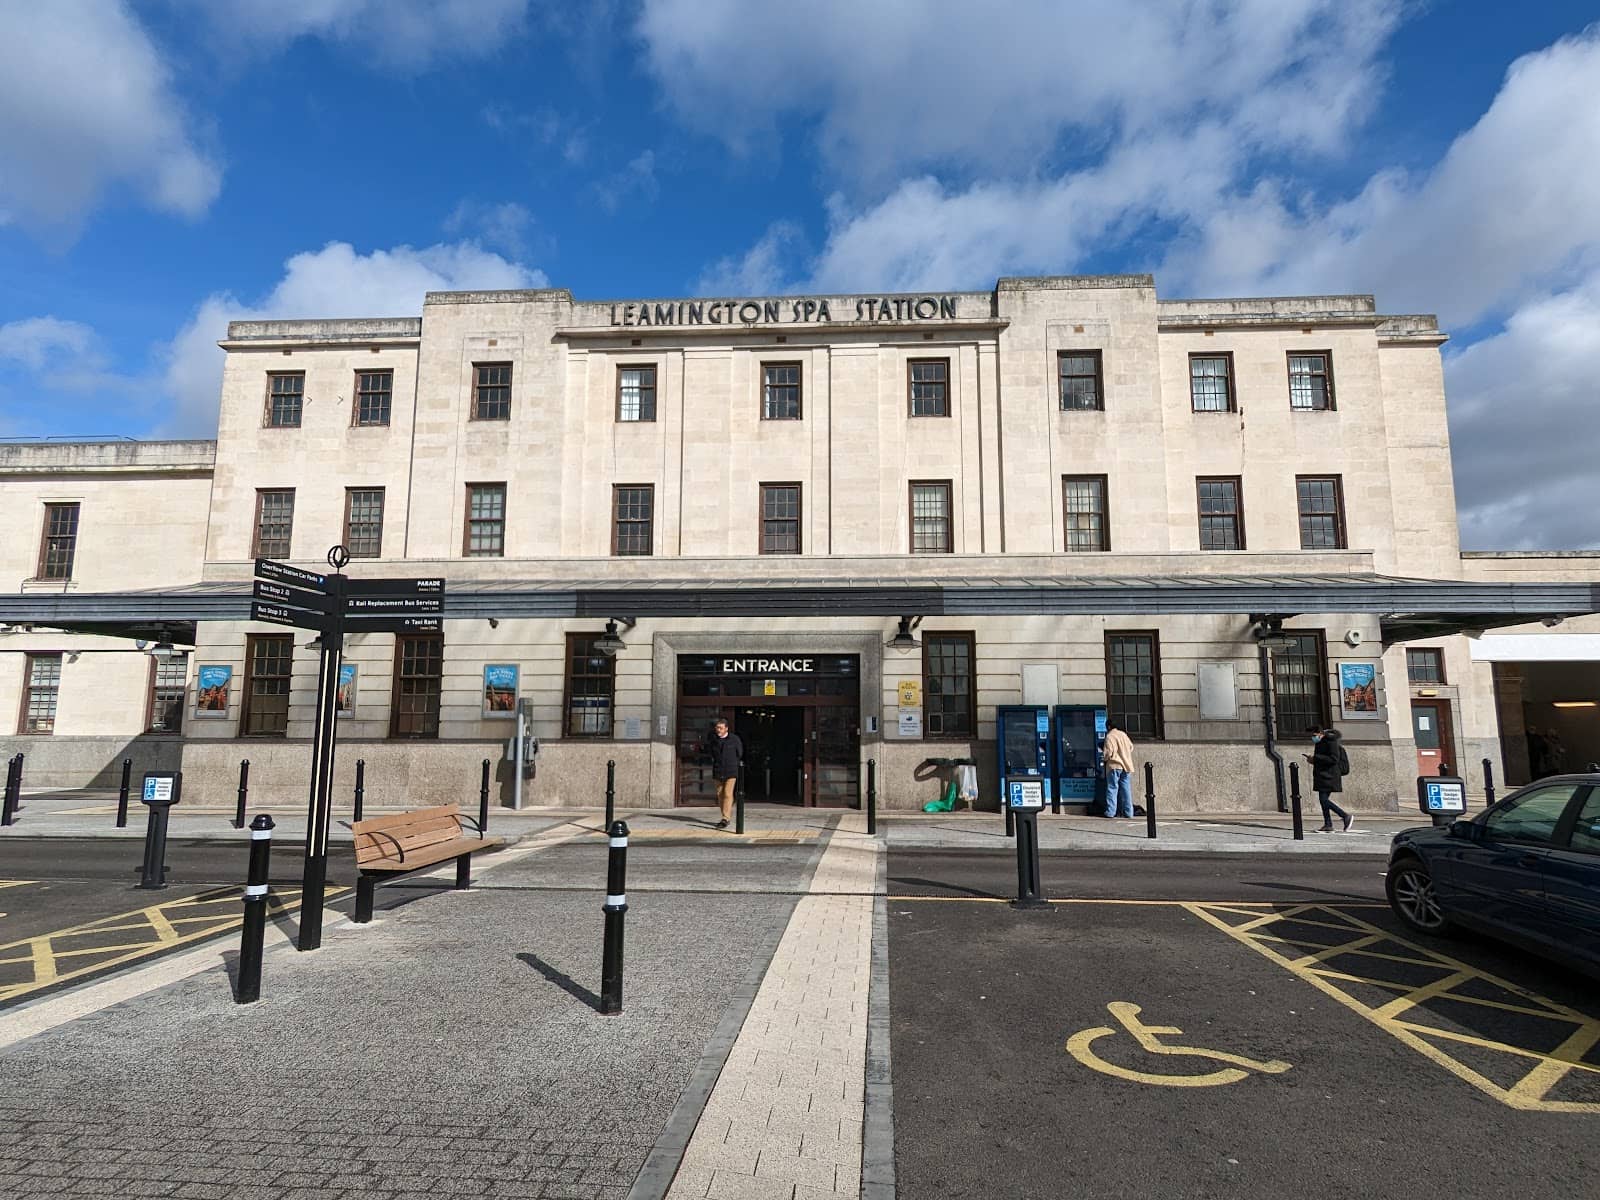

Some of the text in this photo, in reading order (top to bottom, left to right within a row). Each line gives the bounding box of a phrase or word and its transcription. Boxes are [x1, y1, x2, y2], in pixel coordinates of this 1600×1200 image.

[610, 296, 957, 326] LEAMINGTON SPA STATION
[261, 562, 283, 573] Overflow
[283, 568, 299, 577] Station
[260, 583, 269, 592] Bus
[270, 586, 281, 594] Stop
[257, 605, 267, 613] Bus
[267, 607, 278, 616] Stop
[723, 659, 814, 673] ENTRANCE
